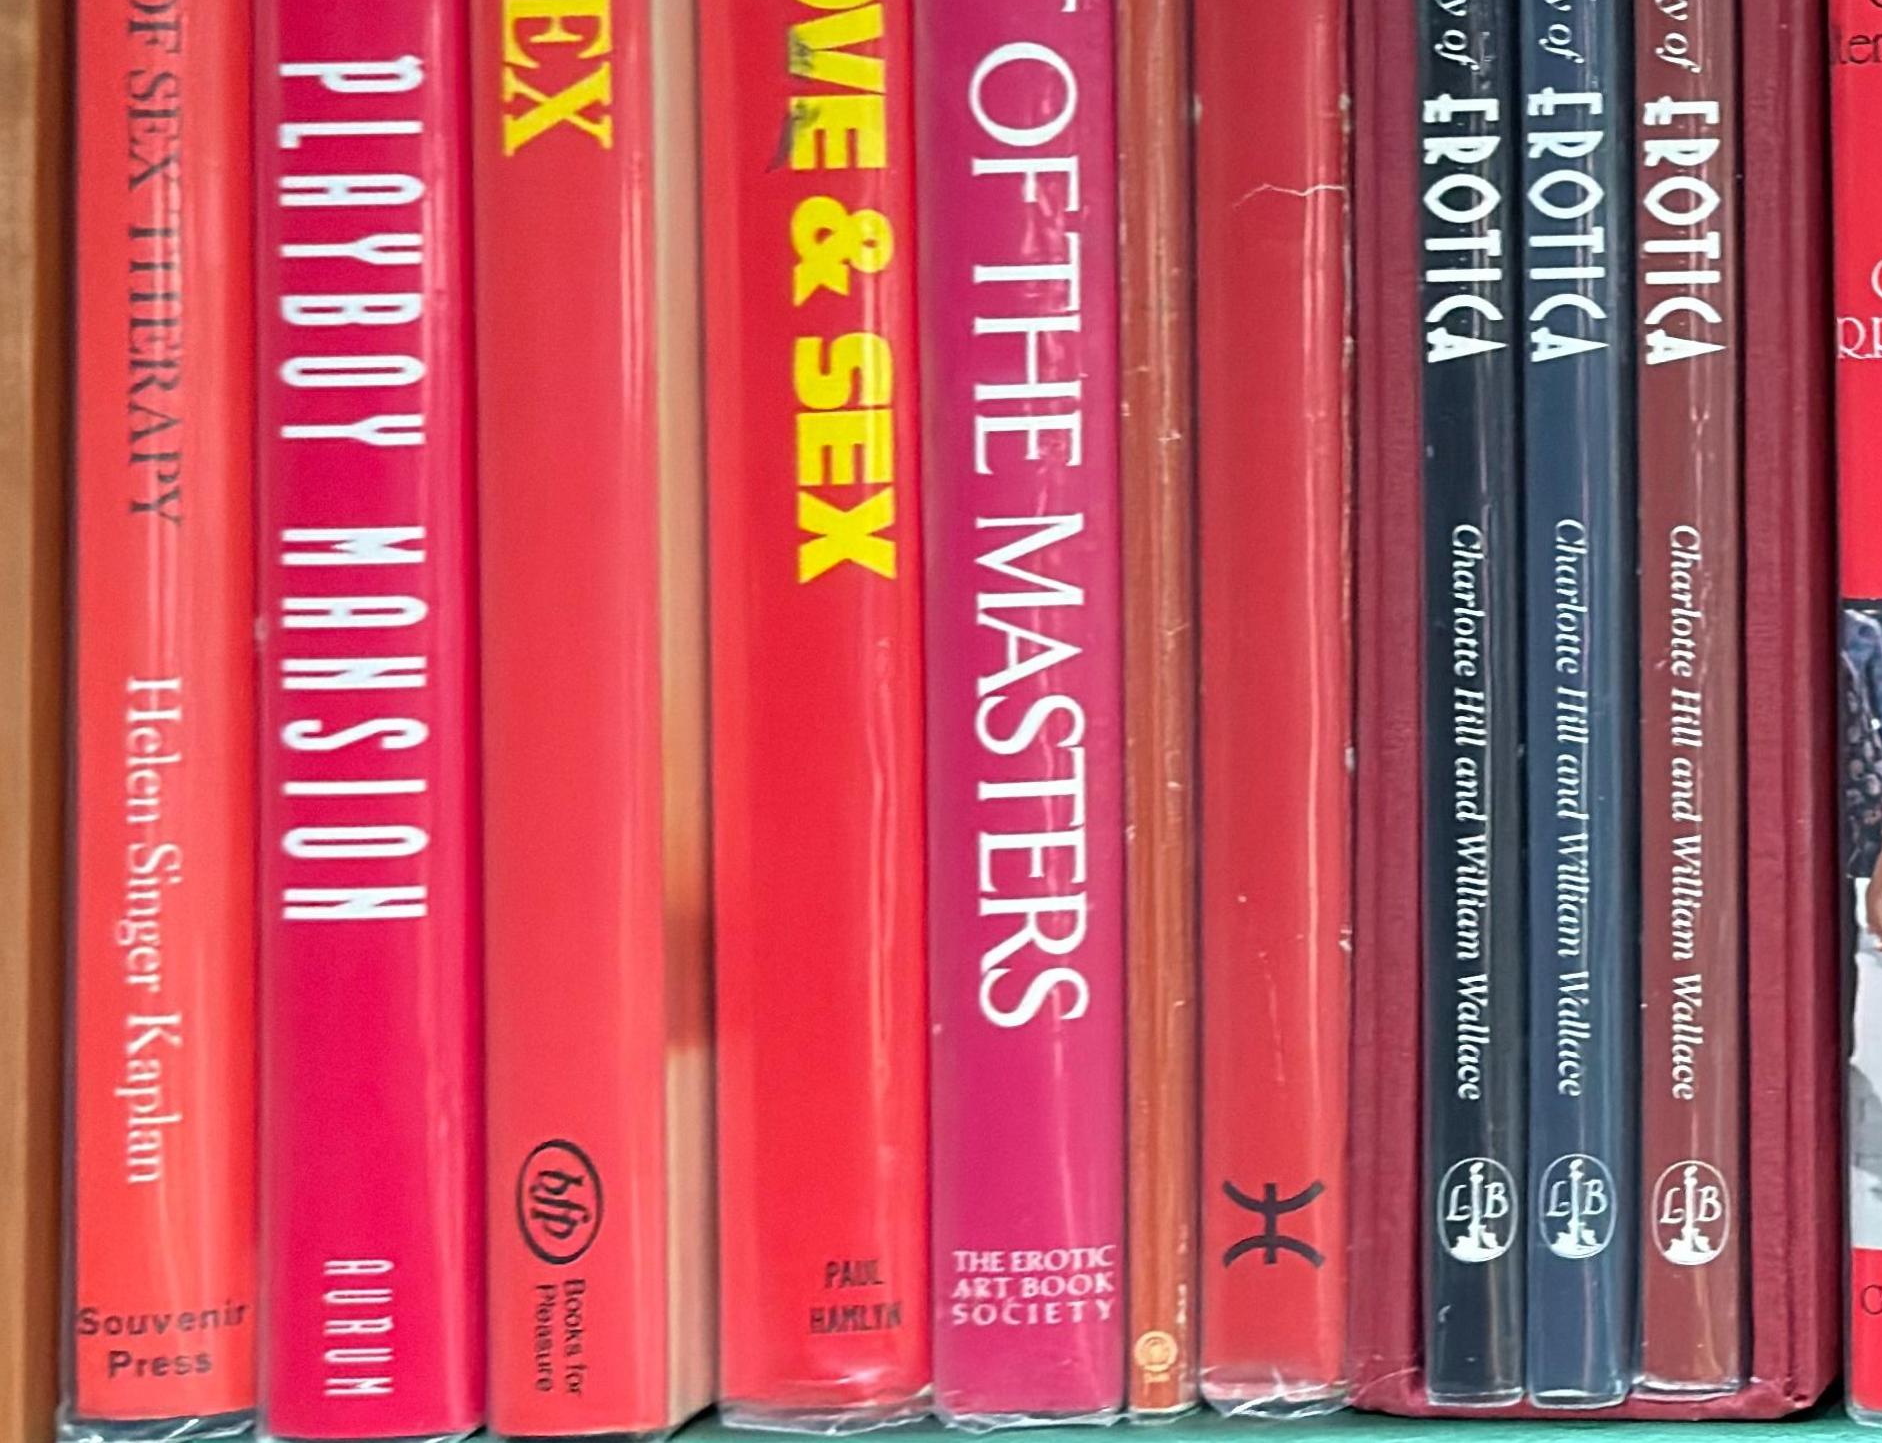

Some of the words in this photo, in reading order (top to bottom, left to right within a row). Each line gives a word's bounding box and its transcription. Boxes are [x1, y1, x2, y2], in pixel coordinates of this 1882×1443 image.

[1434, 33, 1478, 69] of
[127, 70, 183, 192] SEX
[969, 41, 1082, 214] OF
[279, 56, 426, 445] PLAYBOY
[790, 197, 893, 306] &
[1422, 95, 1508, 364] EROTICA
[128, 197, 183, 526] THERAPY
[973, 243, 1083, 475] THE
[793, 333, 897, 584] SEX
[1554, 519, 1588, 673] Charlotte
[125, 675, 182, 825] Helen
[281, 526, 429, 920] MANSION
[973, 515, 1091, 1028] MASTERS
[1555, 686, 1589, 744] Hill
[1556, 758, 1589, 818] and
[115, 842, 182, 994] Singer
[1556, 830, 1590, 959] William
[115, 1012, 182, 1185] Kaplan
[1556, 971, 1592, 1097] Wallace
[77, 1299, 251, 1338] Souvenir
[323, 1259, 393, 1398] AURUM
[952, 1251, 1007, 1272] THE
[1012, 1246, 1114, 1271] EROTIC
[952, 1277, 1011, 1299] ART
[1023, 1273, 1114, 1297] BOOK
[952, 1301, 1113, 1326] SOCIETY
[108, 1348, 212, 1378] Press
